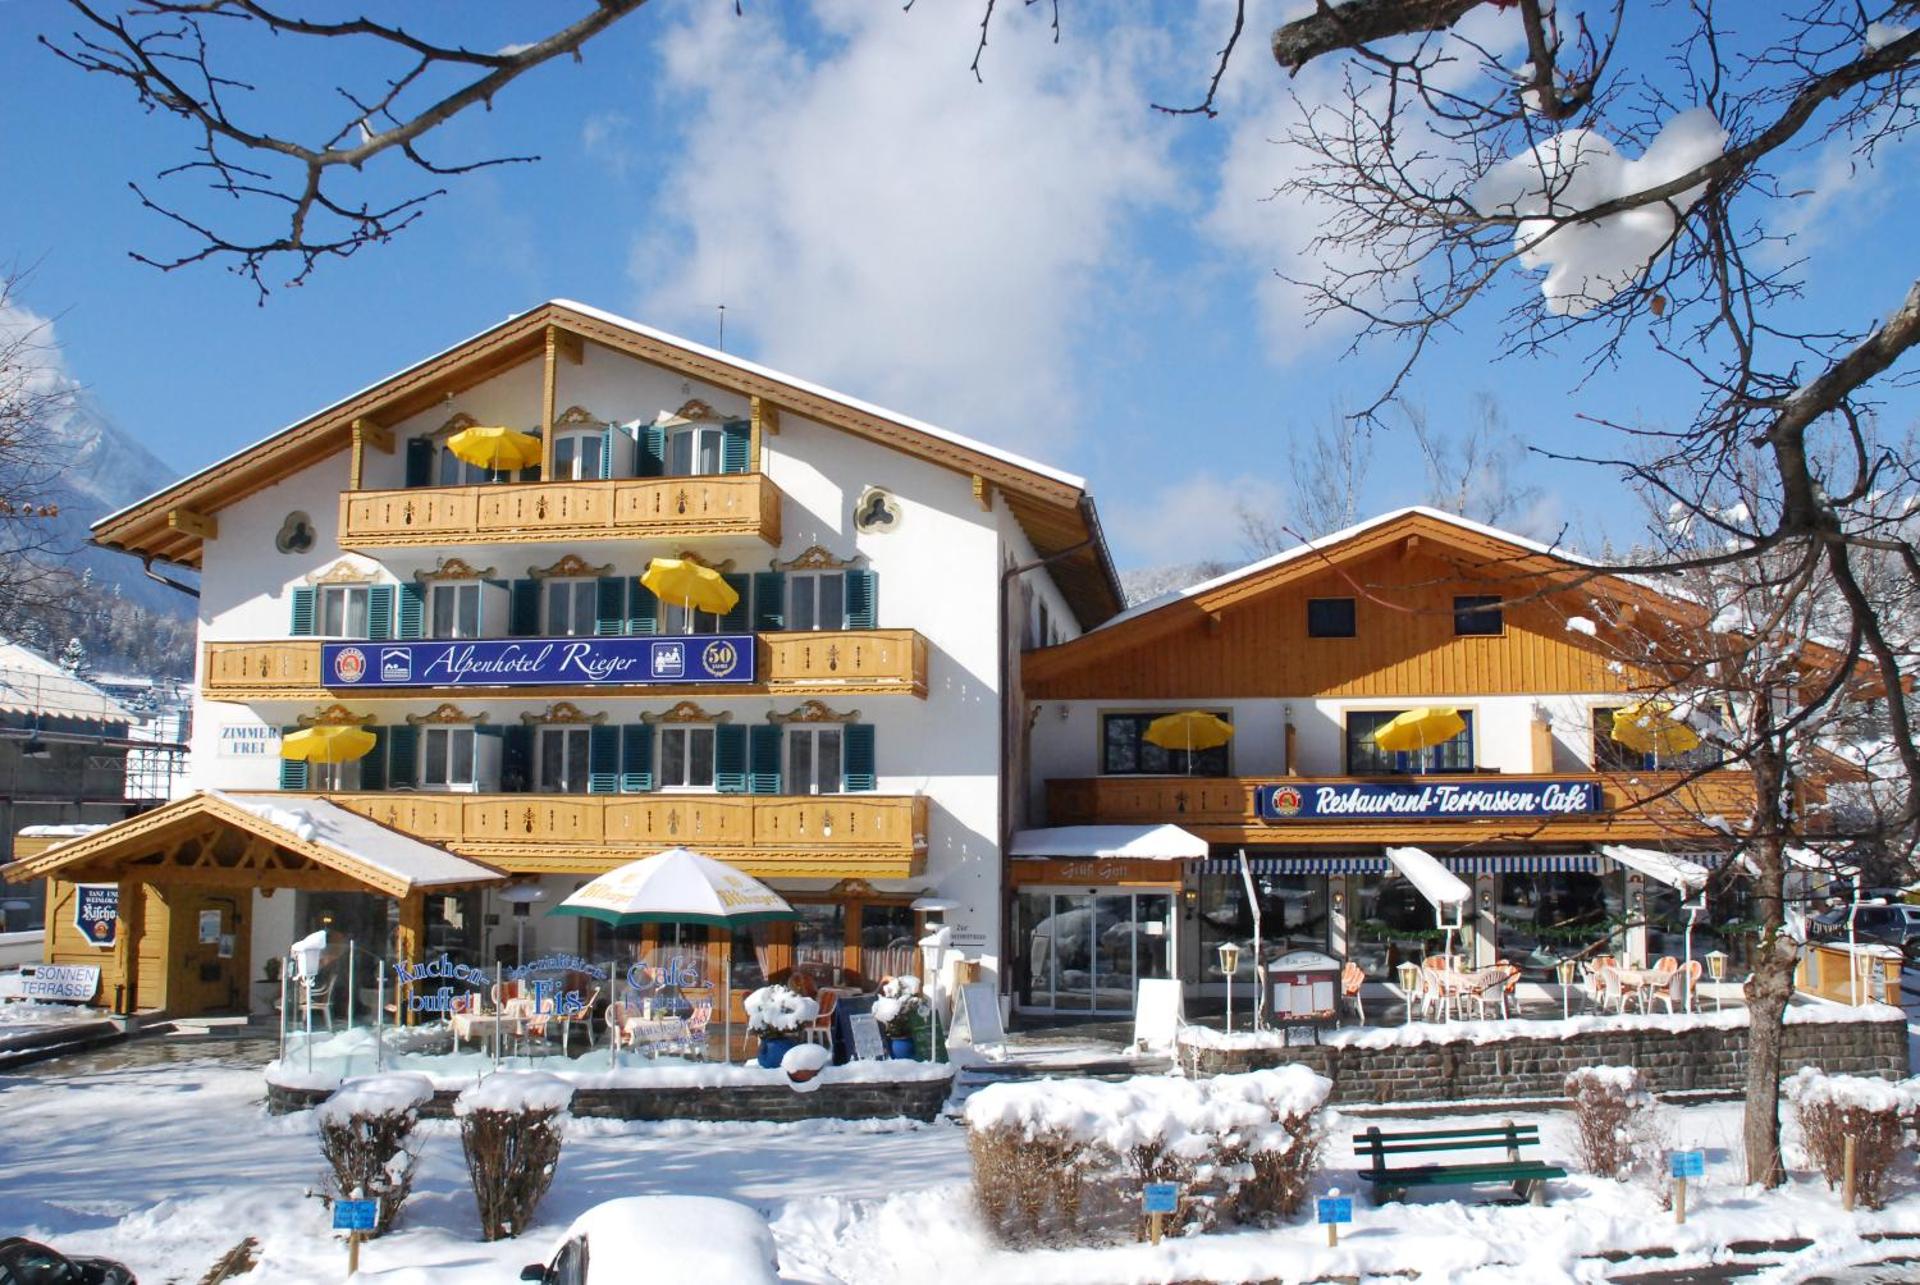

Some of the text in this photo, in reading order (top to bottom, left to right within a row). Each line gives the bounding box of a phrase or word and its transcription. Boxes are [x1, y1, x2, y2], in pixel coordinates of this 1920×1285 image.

[424, 643, 637, 683] Alpenhotel Rieger
[708, 648, 732, 664] 50
[222, 727, 277, 739] ZIMMER
[233, 742, 265, 753] FREI
[1316, 784, 1589, 814] Restaurant Terrassen Café
[36, 966, 95, 981] SONNEN
[22, 981, 92, 997] TERRASSE
